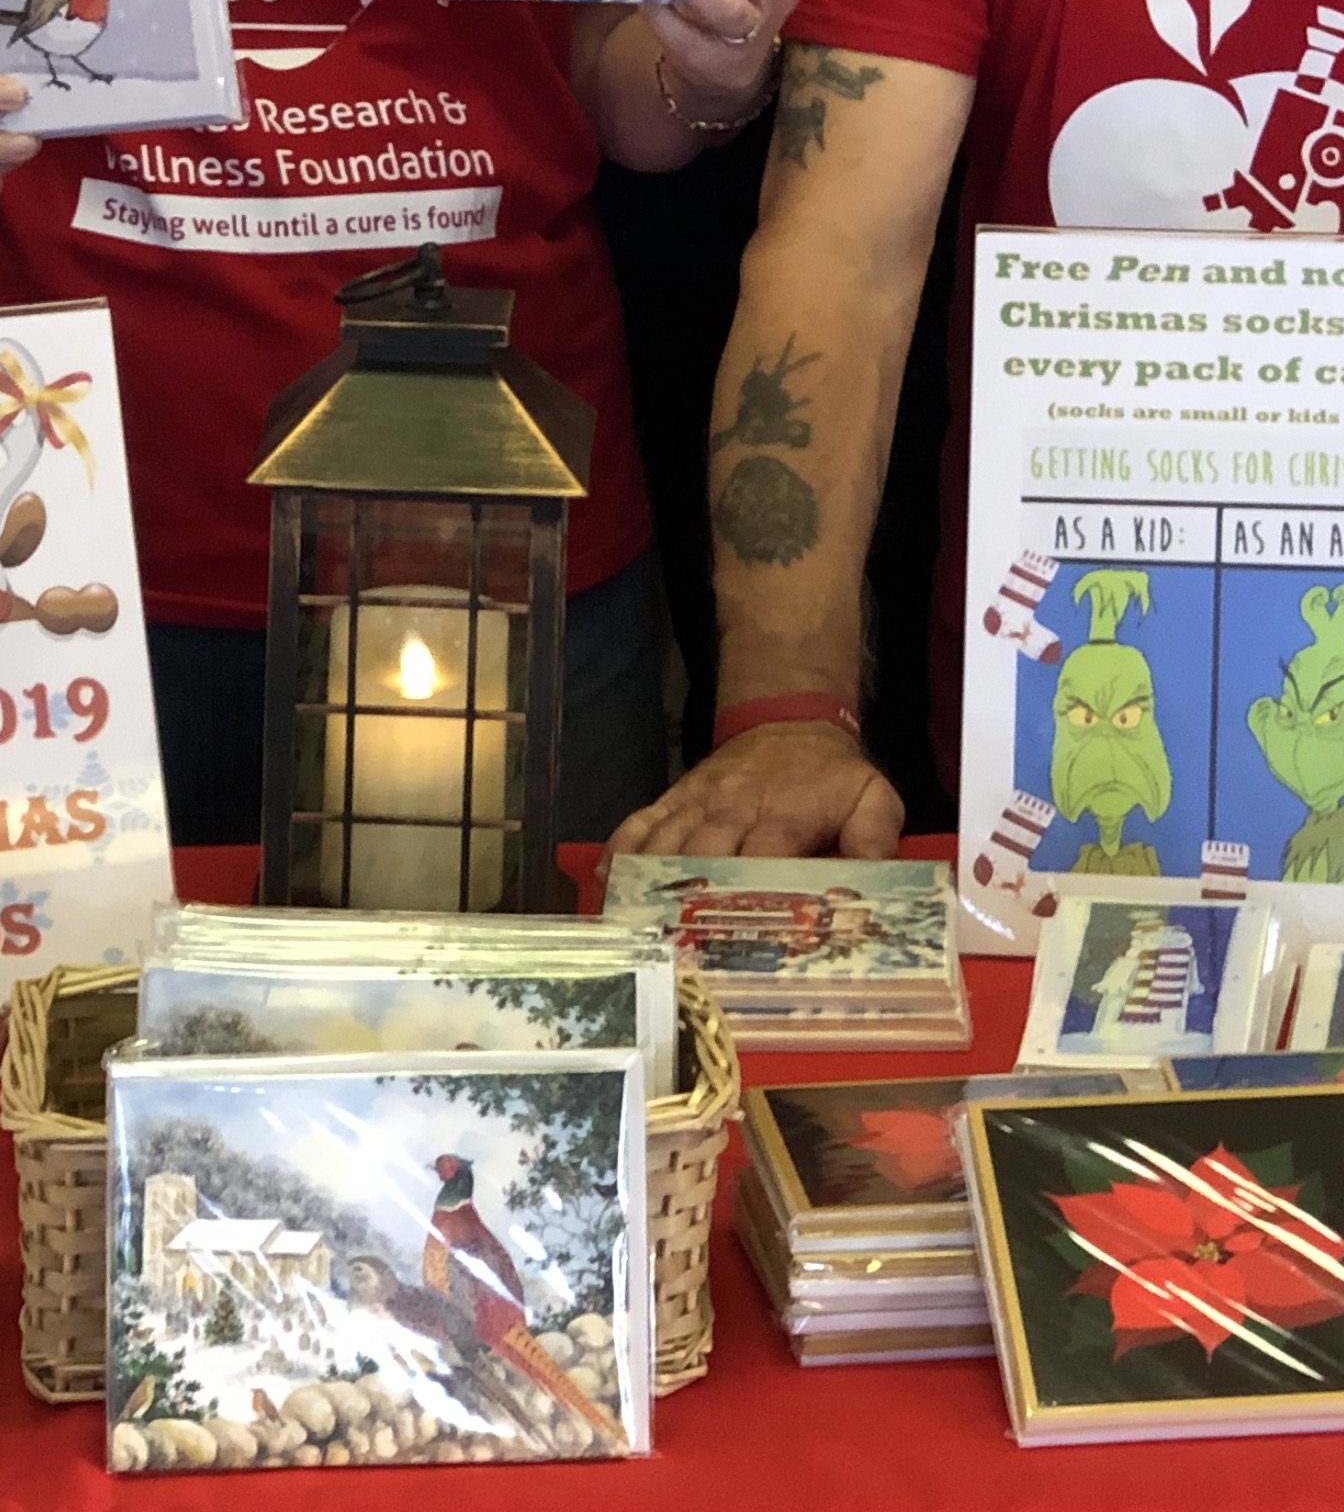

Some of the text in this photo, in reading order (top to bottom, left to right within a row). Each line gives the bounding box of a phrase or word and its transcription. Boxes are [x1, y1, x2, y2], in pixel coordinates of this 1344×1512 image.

[255, 89, 467, 135] Research &
[275, 139, 495, 186] Foundation
[103, 197, 486, 241] Staying well until a cure is found
[995, 252, 1091, 280] Free
[1106, 256, 1190, 283] Pen
[1202, 259, 1287, 286] and
[999, 301, 1208, 333] Chrismas
[1003, 358, 1122, 387] every
[1134, 355, 1243, 387] pack
[1259, 357, 1301, 384] of
[1048, 402, 1124, 421] (socks
[1132, 407, 1172, 421] are
[1180, 406, 1248, 423] small
[1256, 411, 1281, 424] or
[1288, 408, 1339, 426] kids
[1030, 446, 1131, 480] GETTING
[1148, 448, 1219, 483] SOCKS
[1233, 450, 1274, 485] FOR
[1055, 516, 1184, 552] AS A KID:
[1234, 521, 1265, 556] AS
[1280, 522, 1313, 556] AN
